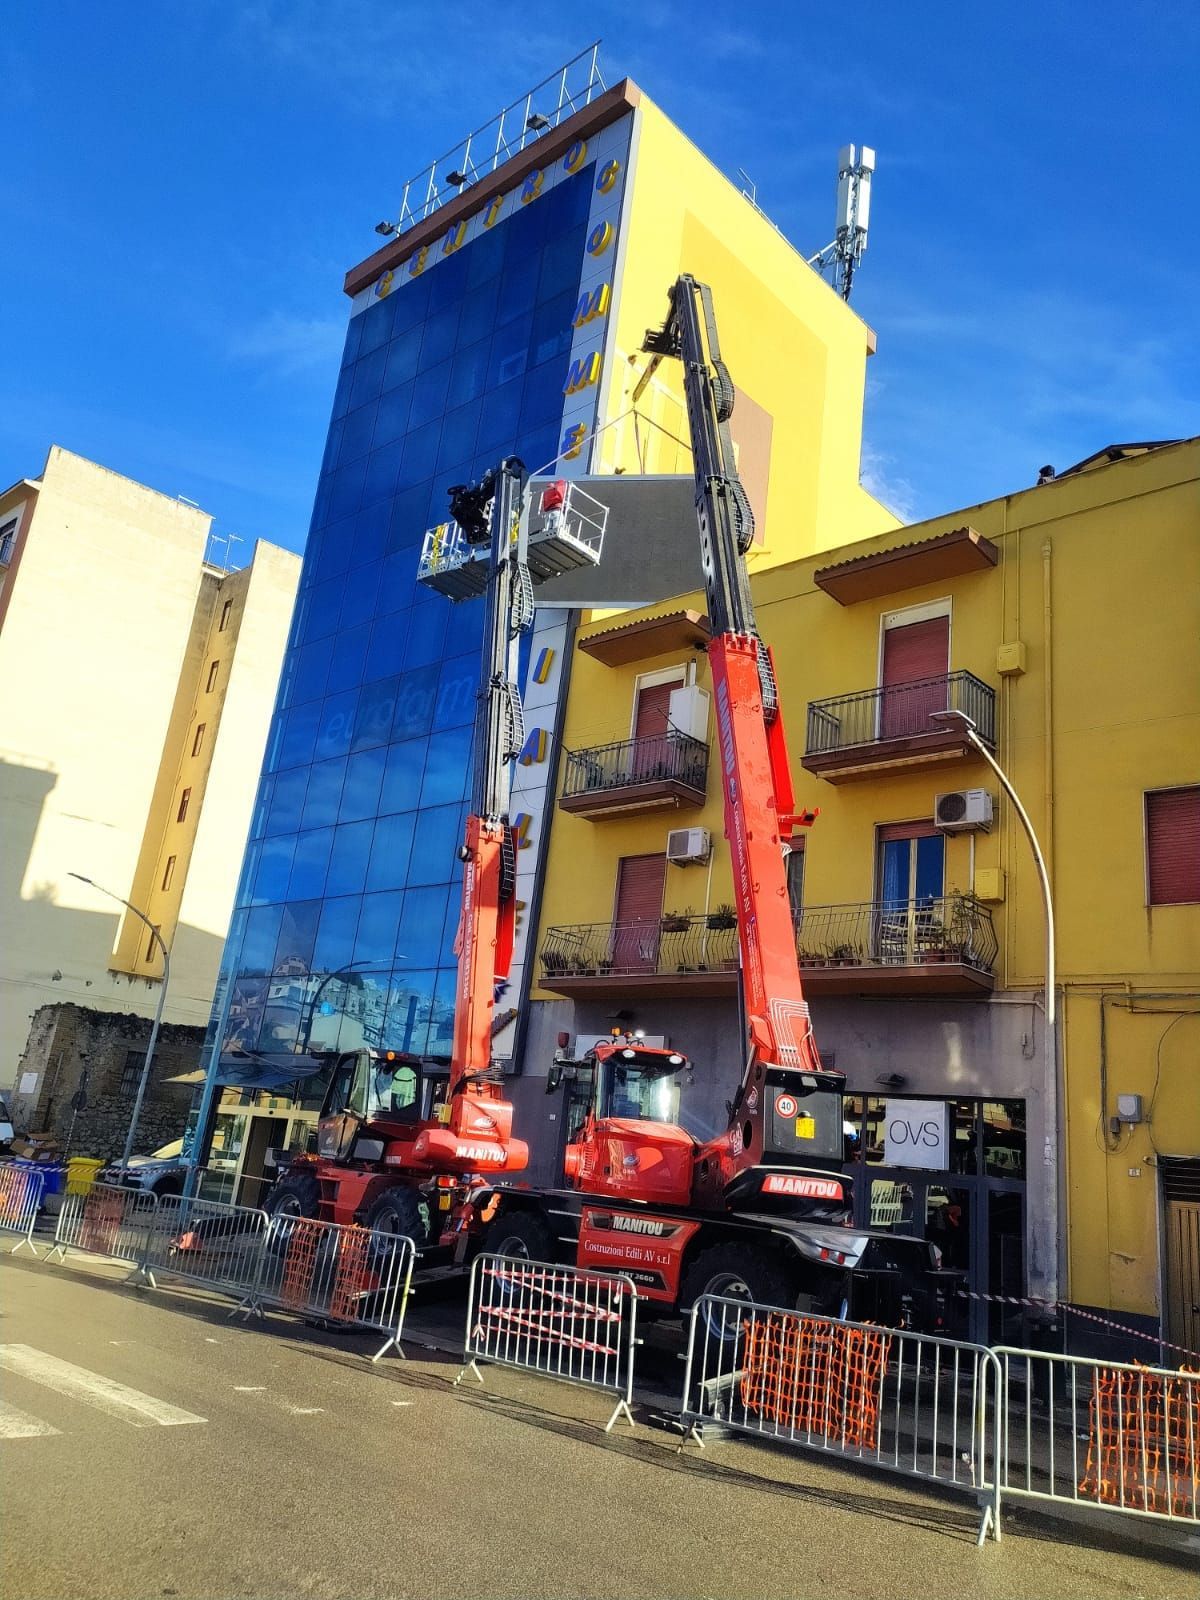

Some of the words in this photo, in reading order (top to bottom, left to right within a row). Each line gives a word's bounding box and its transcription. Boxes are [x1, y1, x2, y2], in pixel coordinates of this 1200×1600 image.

[375, 139, 587, 298] CENTRO
[781, 1101, 791, 1111] 40
[889, 1119, 940, 1147] OVS
[456, 1146, 508, 1162] MANITOU
[768, 1176, 837, 1196] MANITOU
[613, 1216, 663, 1235] MANITOU
[584, 1240, 624, 1257] Costruzioni
[625, 1246, 642, 1260] Edili
[643, 1250, 656, 1262] AV
